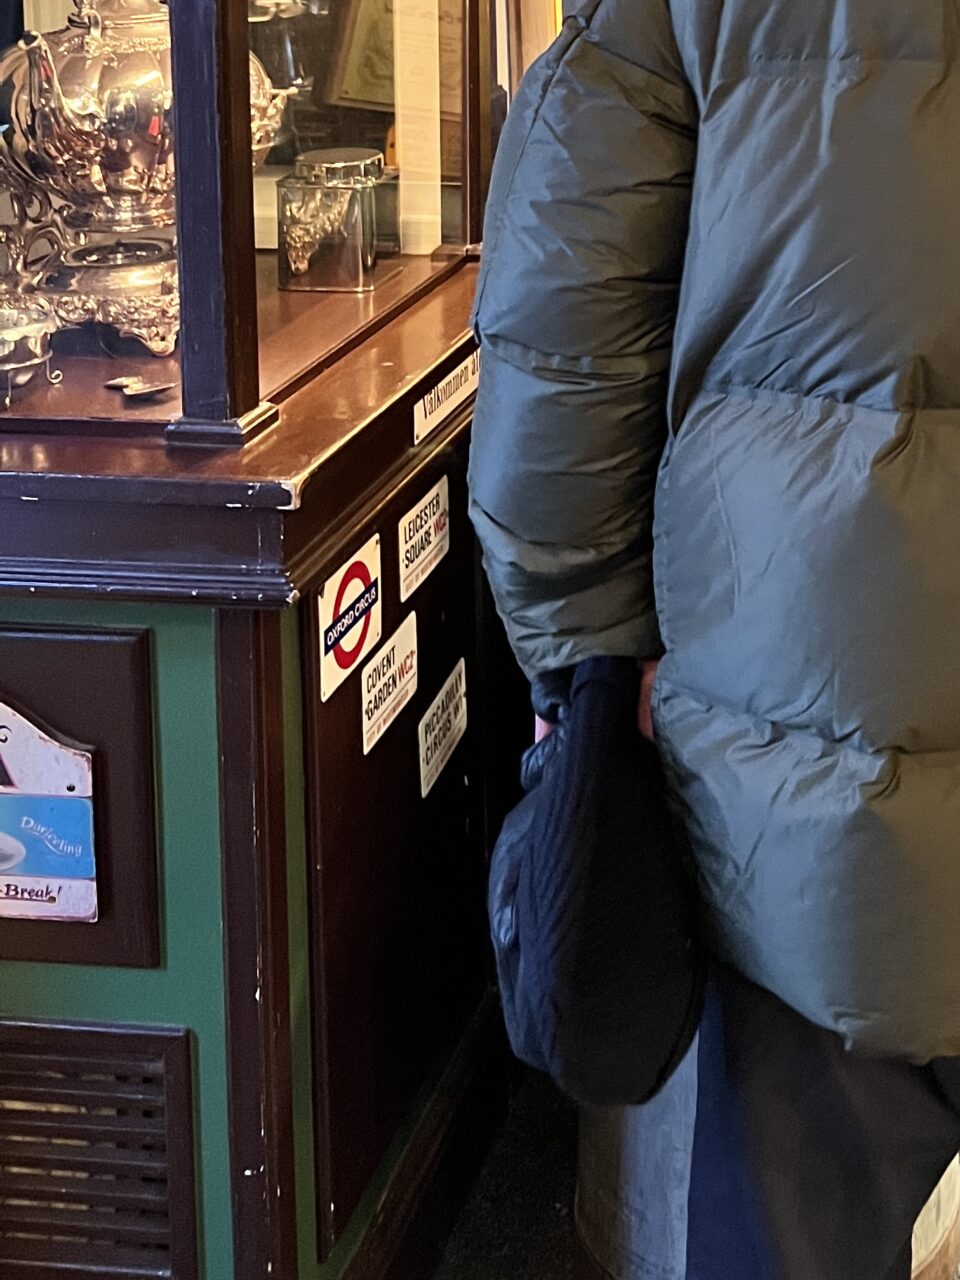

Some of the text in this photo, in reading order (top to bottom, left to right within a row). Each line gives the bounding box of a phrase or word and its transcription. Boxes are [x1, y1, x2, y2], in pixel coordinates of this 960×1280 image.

[404, 492, 440, 545] LEICESTER
[405, 525, 432, 569] SQUARE
[327, 586, 376, 646] OXFORD CIRCUS
[366, 645, 397, 694] COVENT
[366, 670, 398, 721] GARDEN
[20, 816, 83, 857] Darjeeling
